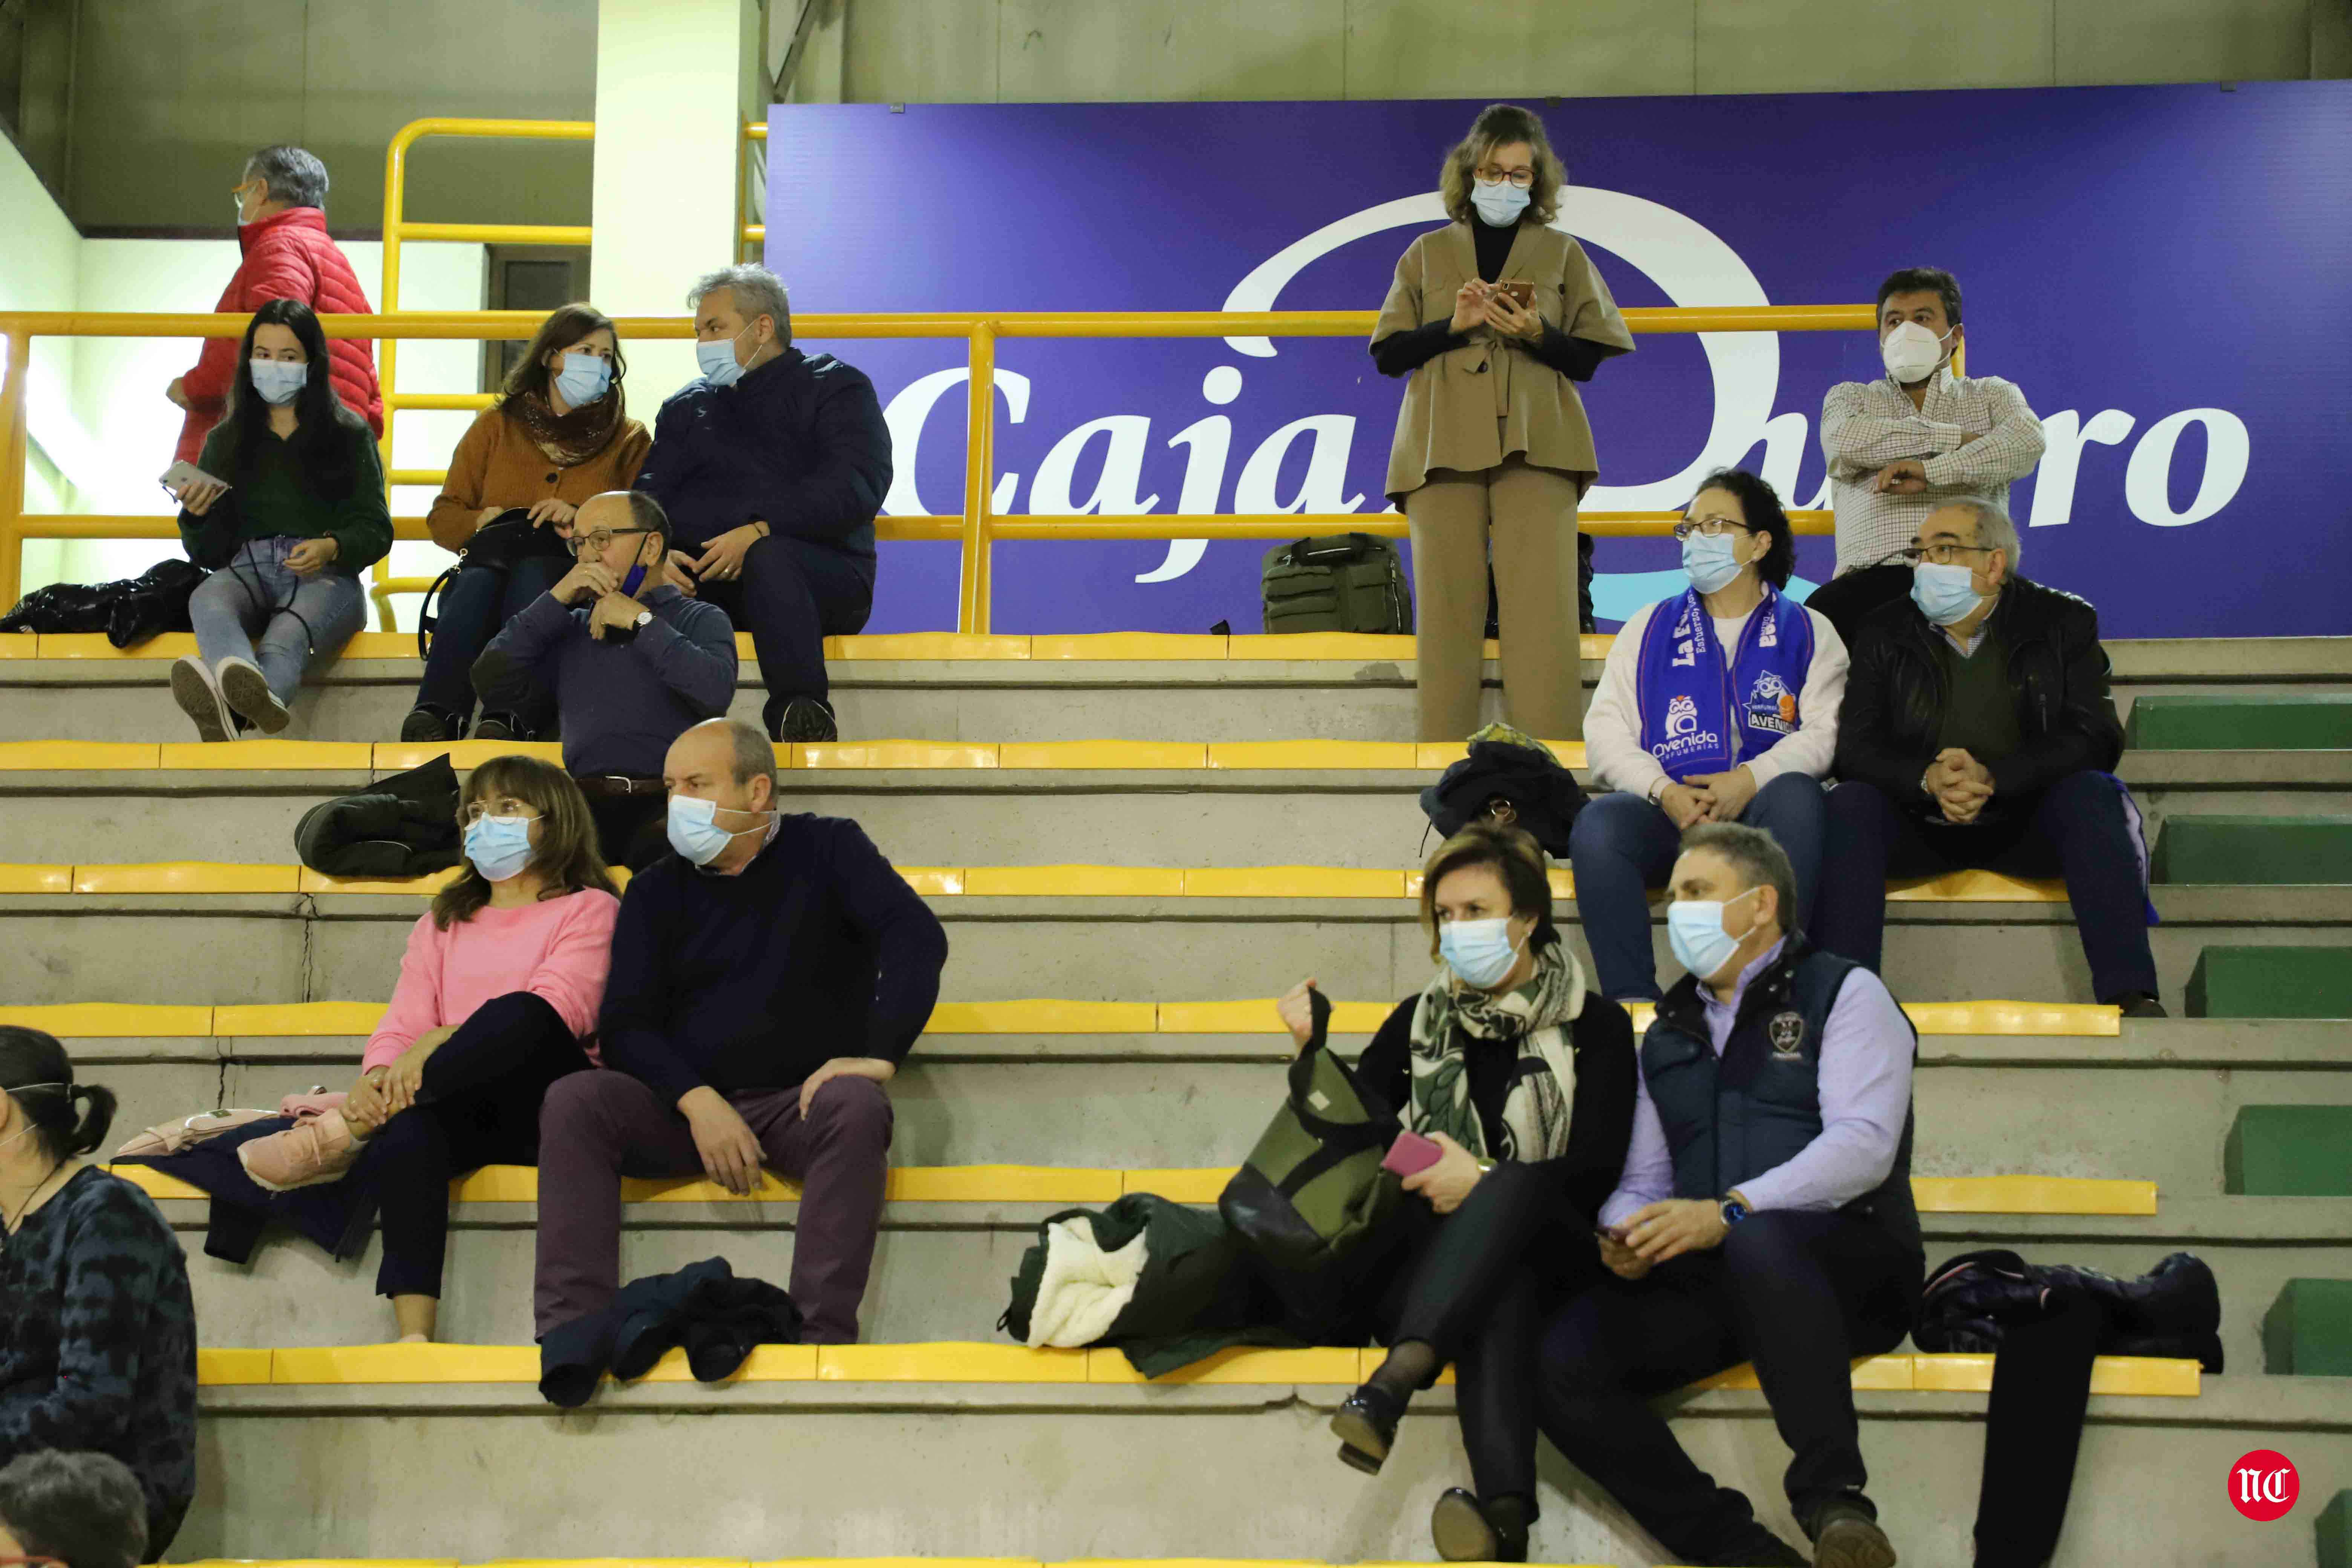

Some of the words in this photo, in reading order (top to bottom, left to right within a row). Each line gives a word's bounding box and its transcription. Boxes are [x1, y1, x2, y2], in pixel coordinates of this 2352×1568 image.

[882, 366, 1365, 583] Caja
[1223, 185, 2249, 528] Duro
[1672, 639, 1695, 667] La
